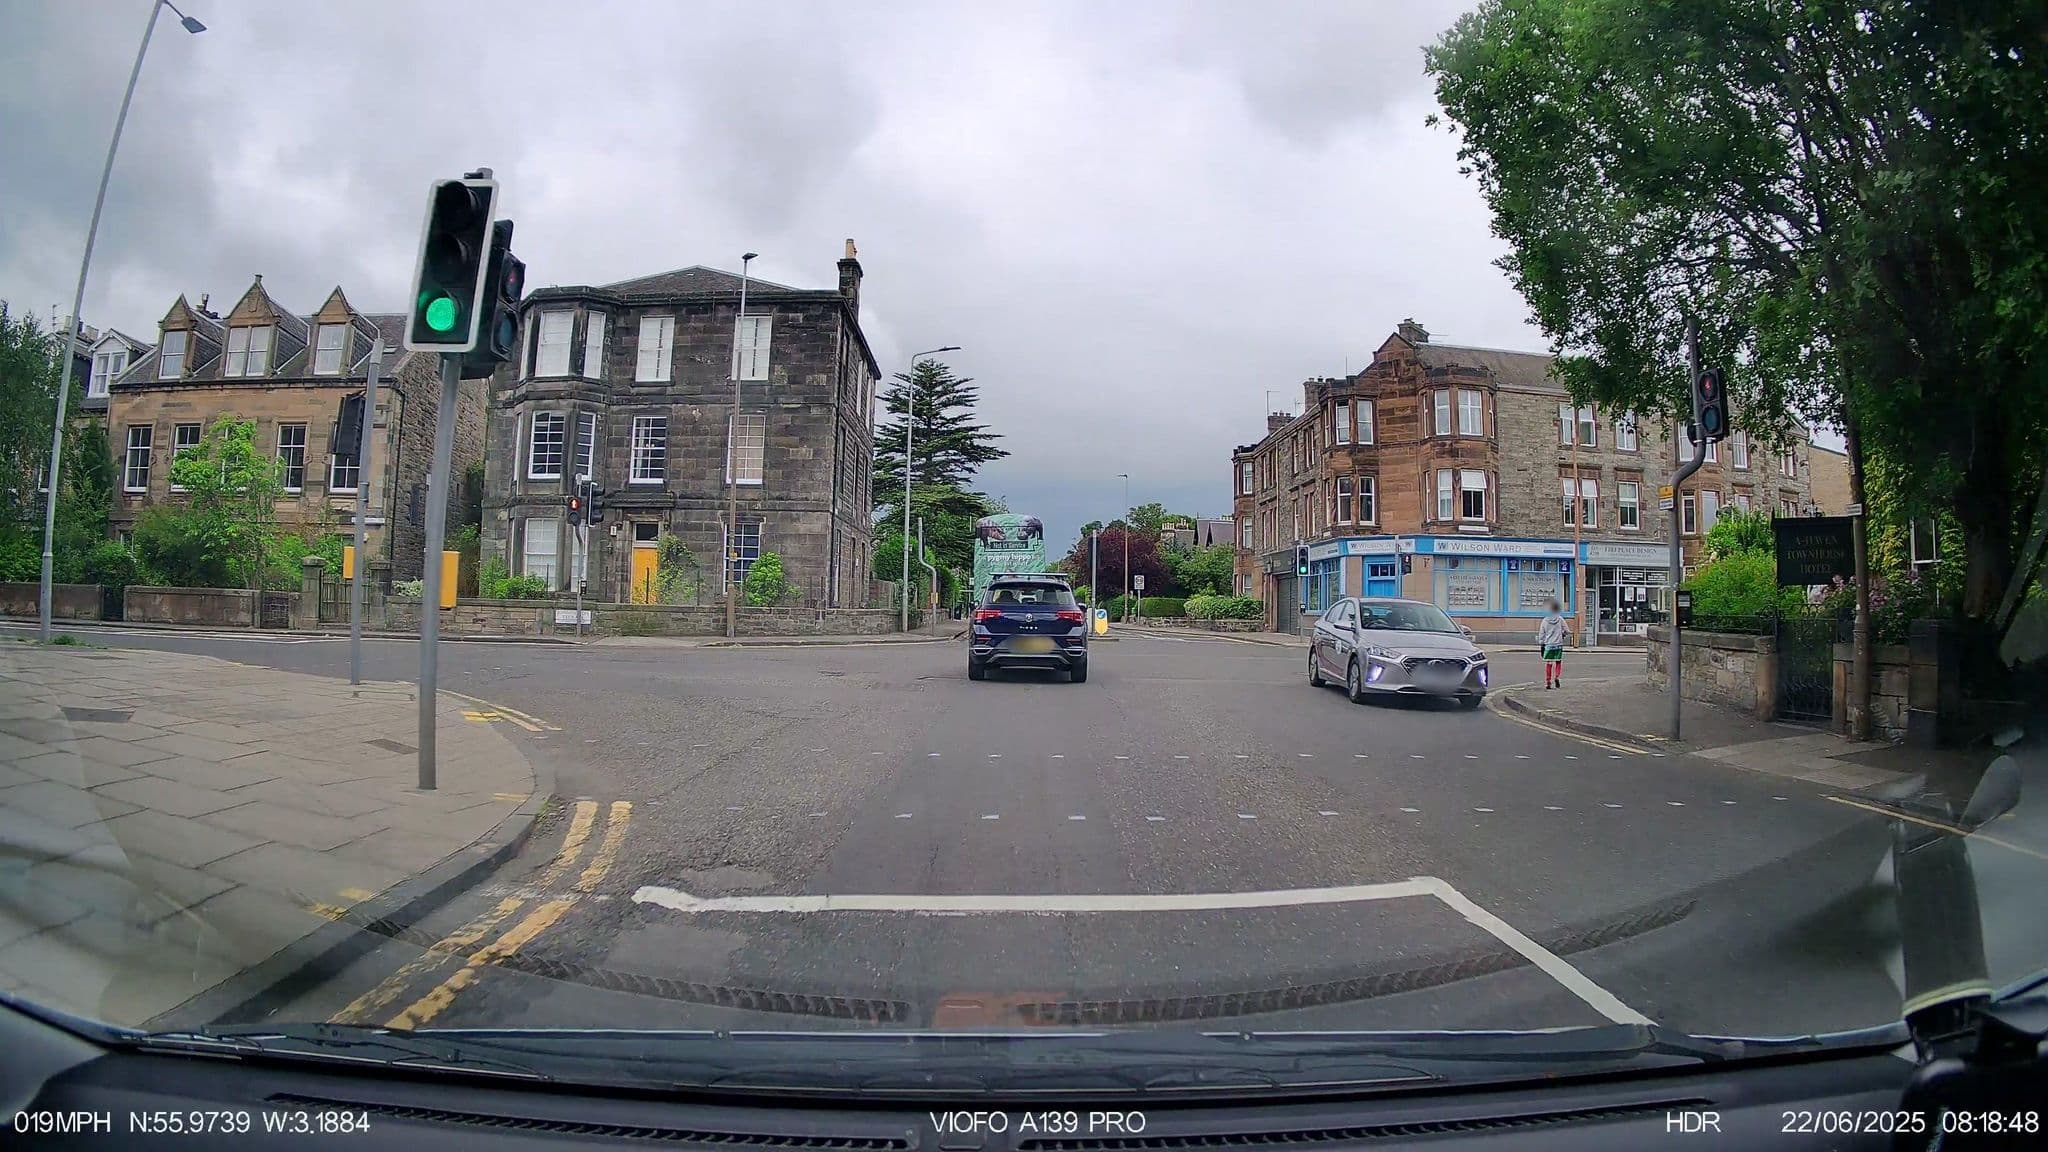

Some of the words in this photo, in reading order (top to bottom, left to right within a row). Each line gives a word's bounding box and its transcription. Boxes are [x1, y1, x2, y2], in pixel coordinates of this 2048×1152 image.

[1450, 542, 1490, 552] WILSON
[1494, 544, 1522, 553] WARD
[987, 554, 1011, 562] pygmy
[1787, 550, 1845, 560] TOWNHOUSE
[1800, 563, 1832, 574] HOTEL
